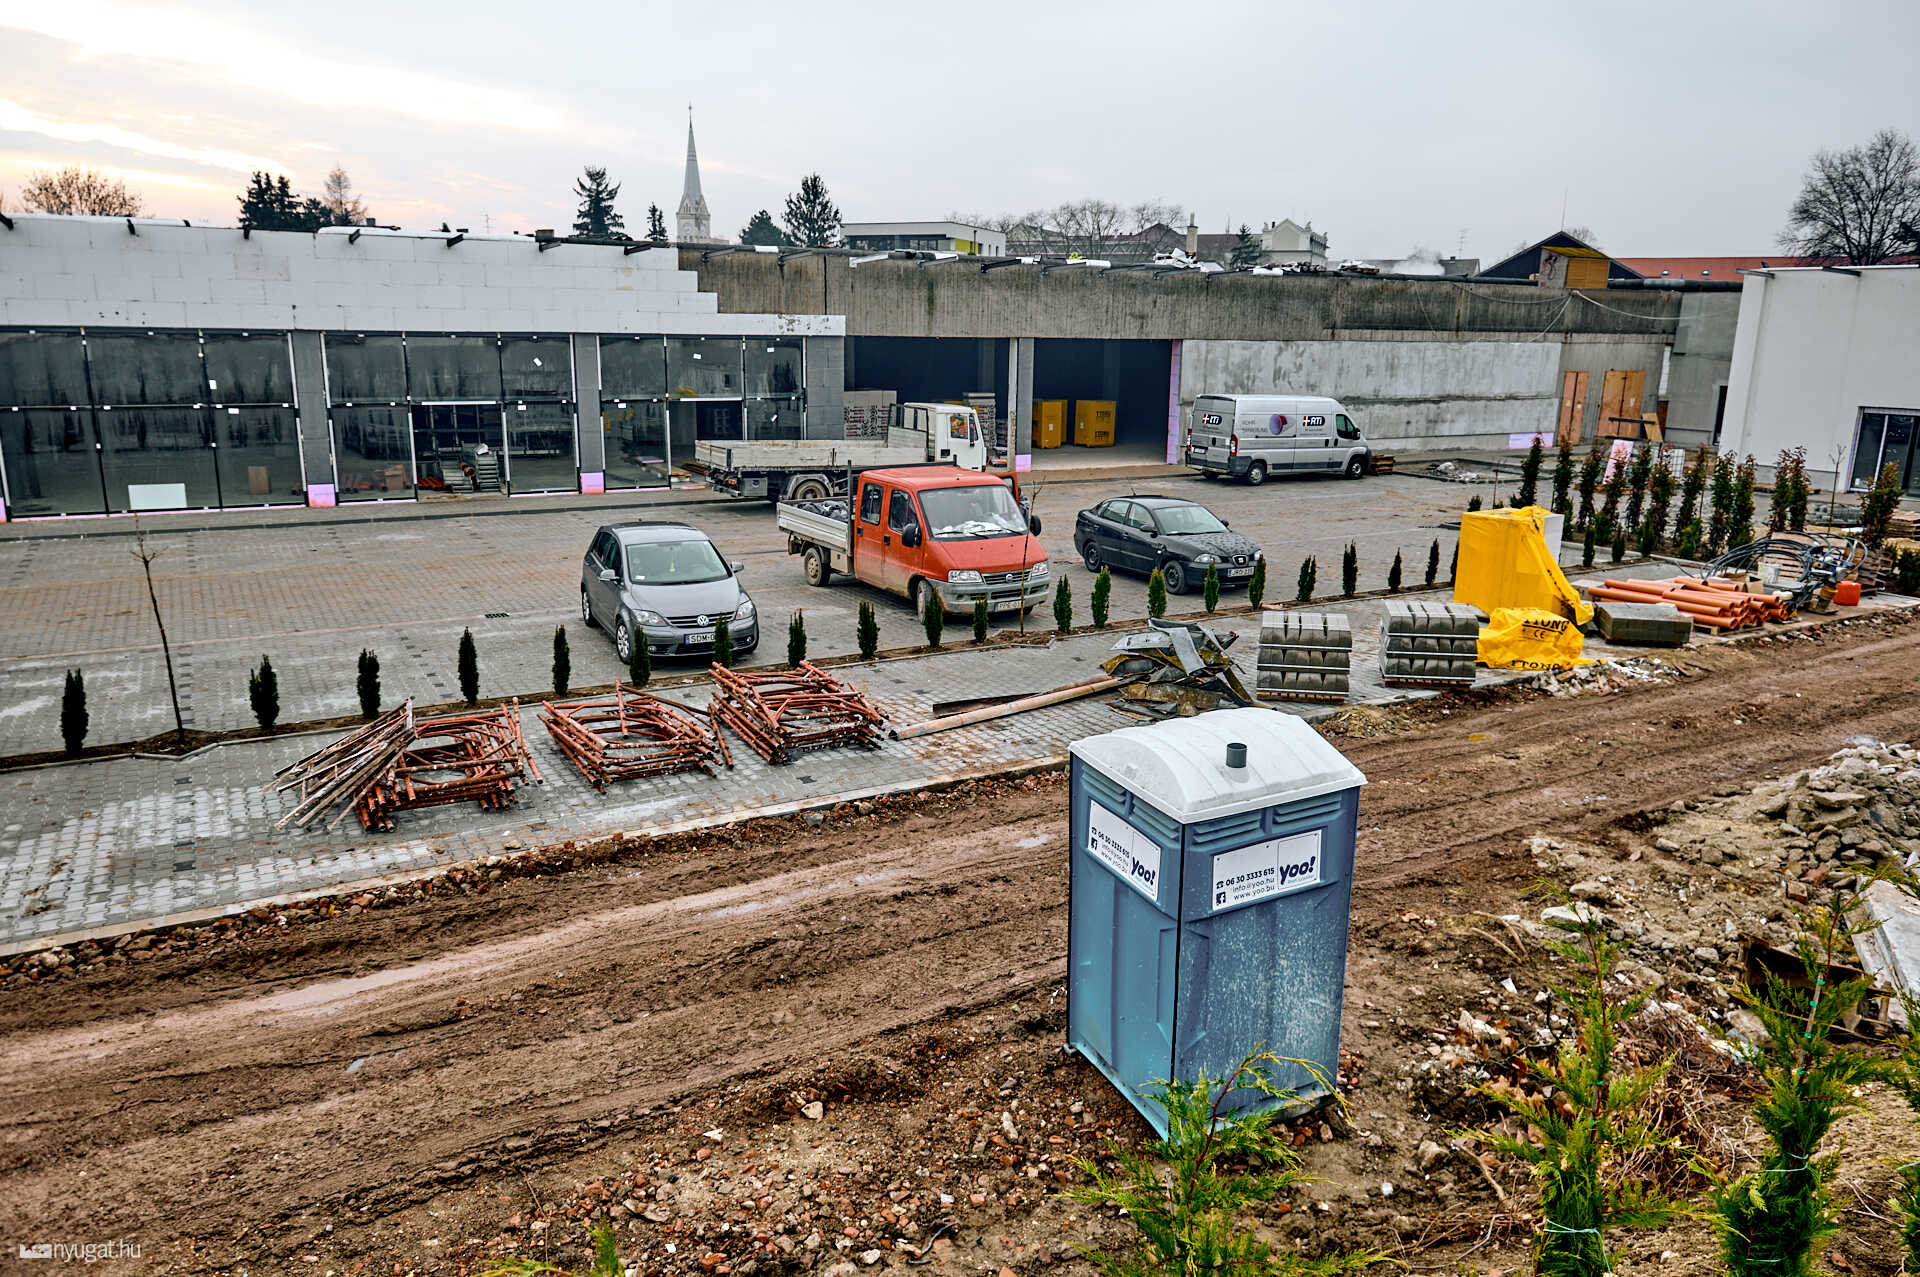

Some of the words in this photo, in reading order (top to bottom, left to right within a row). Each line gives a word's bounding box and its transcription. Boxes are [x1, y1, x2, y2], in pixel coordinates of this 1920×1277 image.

[1131, 856, 1156, 886] yoo!
[1225, 878, 1235, 886] 06
[1236, 875, 1245, 884] 30
[1246, 870, 1263, 881] 3333
[1263, 867, 1275, 876] 615
[1279, 856, 1316, 885] yoo!
